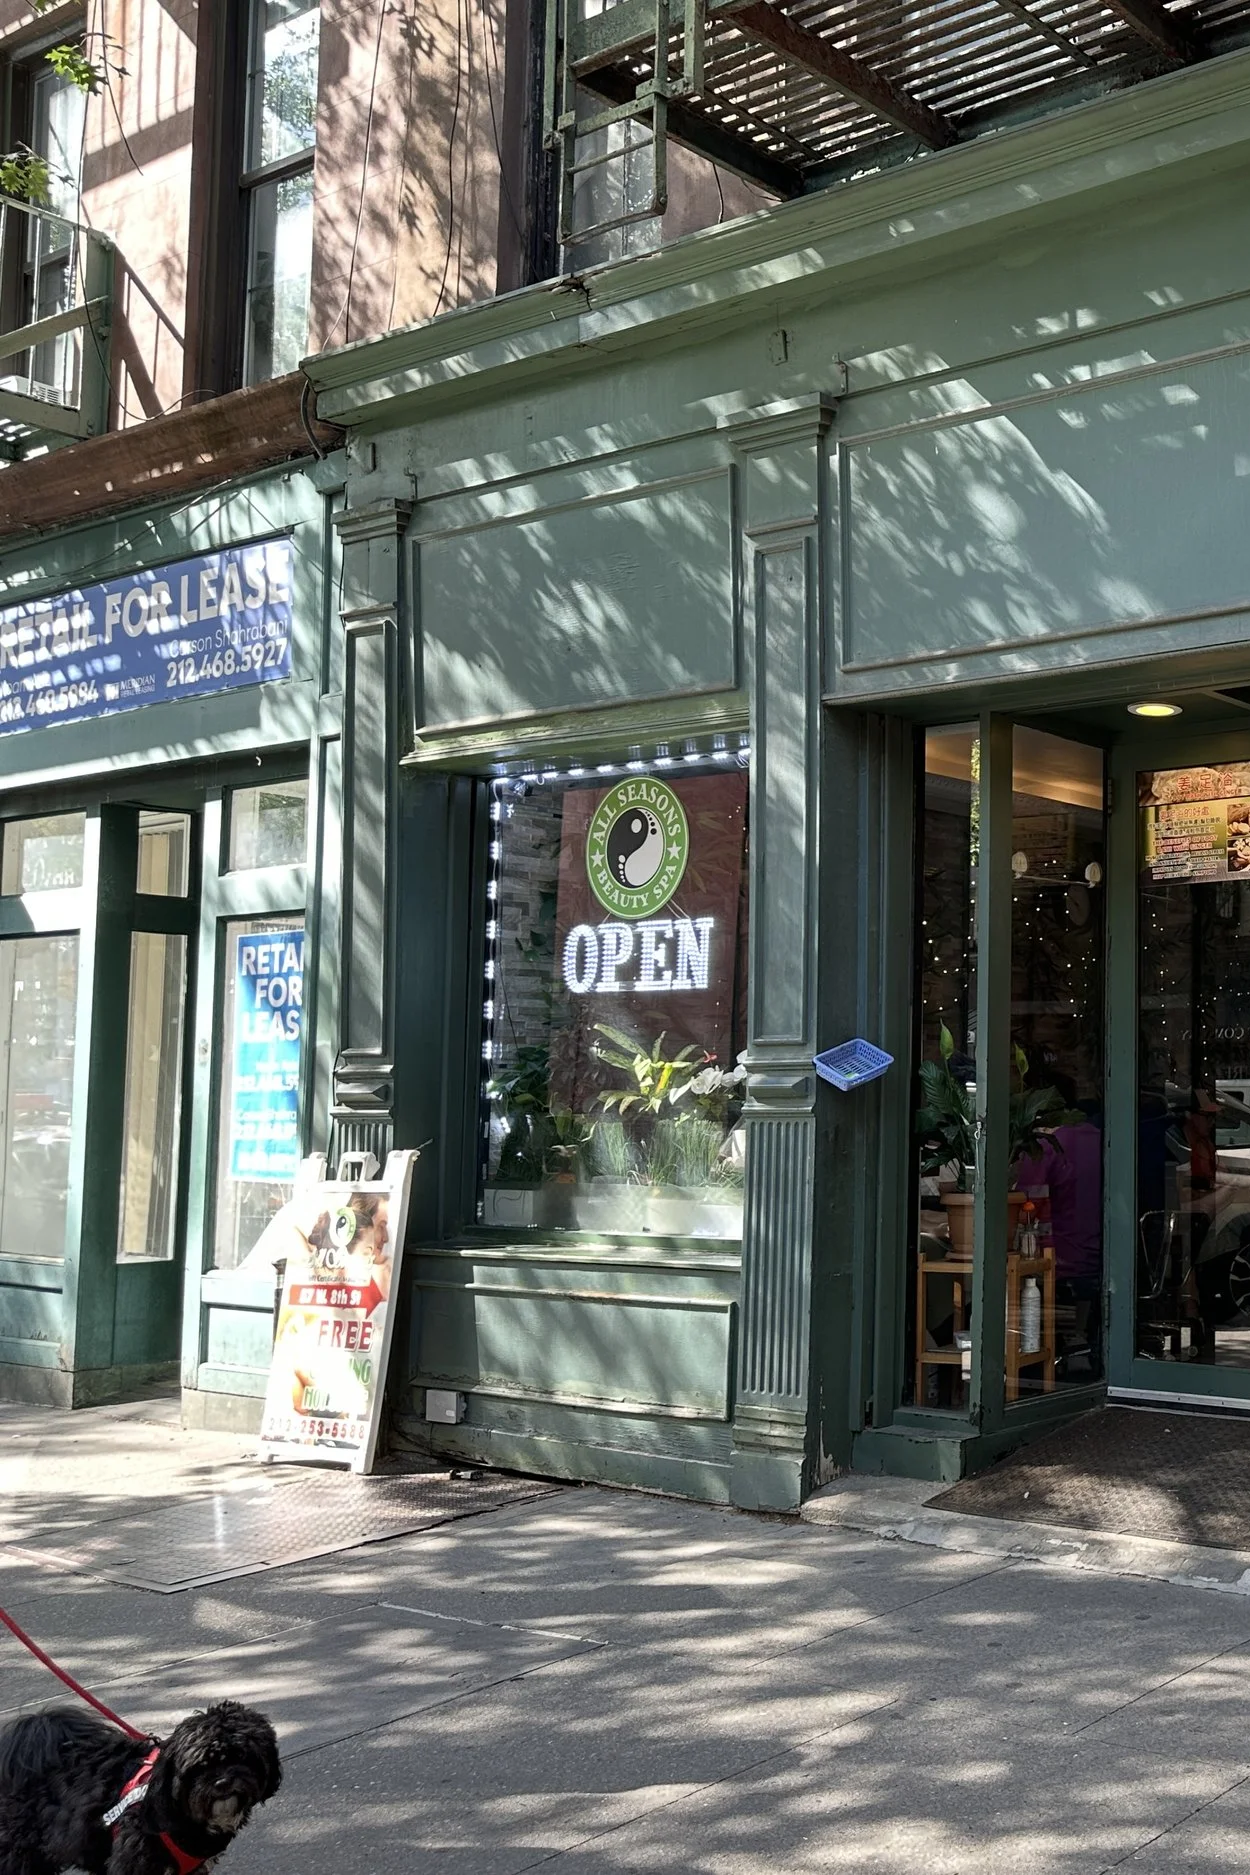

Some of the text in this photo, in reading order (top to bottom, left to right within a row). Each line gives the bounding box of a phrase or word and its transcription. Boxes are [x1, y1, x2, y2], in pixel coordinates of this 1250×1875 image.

[0, 548, 291, 669] RETAIL FOR LEASE
[169, 616, 289, 659] Cson Shahrabani
[120, 674, 156, 690] MERIDIAN
[166, 637, 289, 688] 212.468.5927
[593, 782, 683, 845] ALL SEASONS
[596, 863, 678, 909] BEAUTY SPA
[563, 917, 715, 994] OPEN
[255, 975, 303, 1009] FOR
[330, 1289, 348, 1305] 8th
[317, 1319, 375, 1353] FREE
[269, 1417, 366, 1440] 212-253-5588
